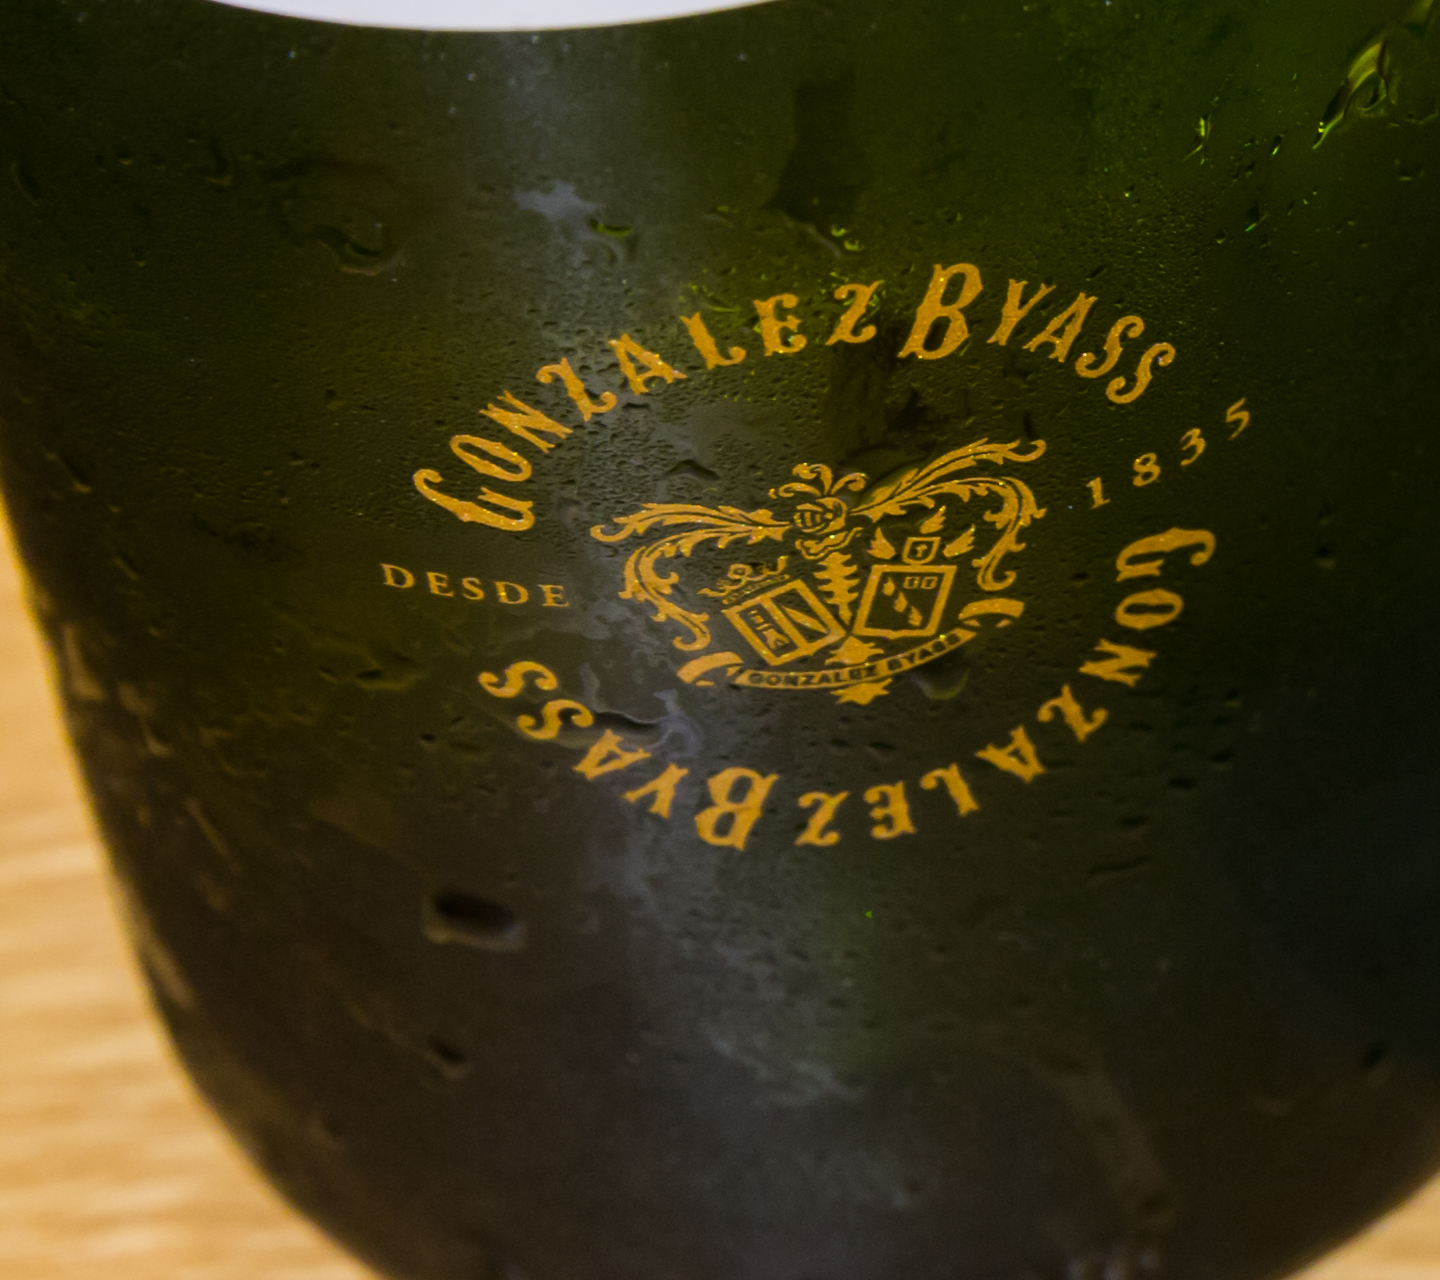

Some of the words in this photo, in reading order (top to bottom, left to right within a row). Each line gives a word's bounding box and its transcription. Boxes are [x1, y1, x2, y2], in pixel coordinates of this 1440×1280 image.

[379, 561, 572, 610] DESDE
[1083, 396, 1253, 512] 1835
[412, 278, 885, 533] GONZALEZ
